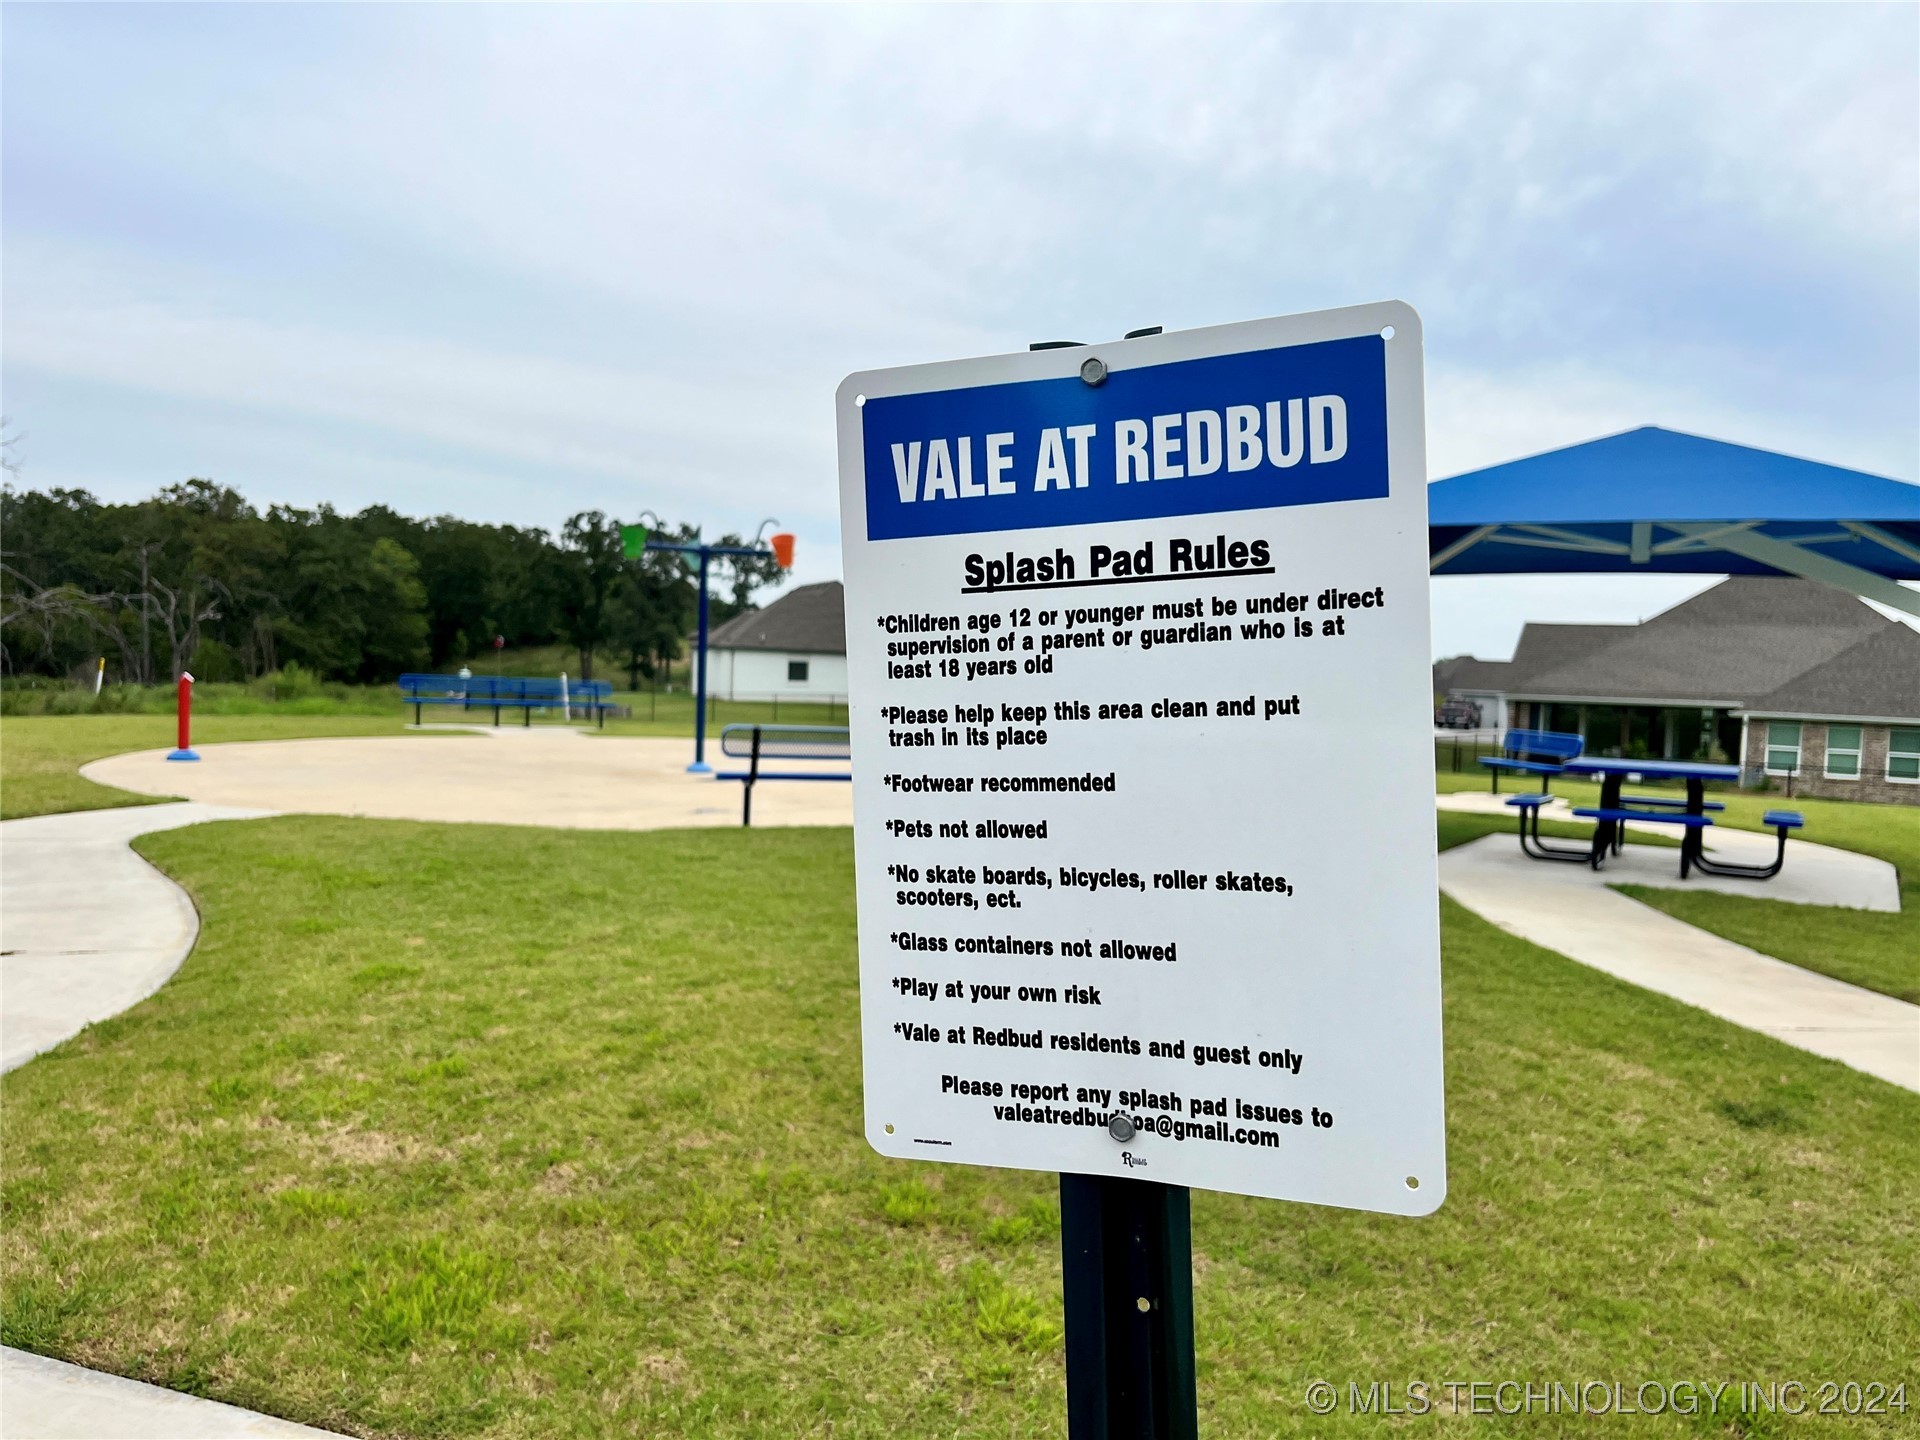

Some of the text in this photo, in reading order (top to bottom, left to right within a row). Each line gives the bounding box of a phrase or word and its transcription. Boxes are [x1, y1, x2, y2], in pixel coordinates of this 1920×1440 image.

[891, 394, 1347, 502] VALE AT REDBUD
[964, 534, 1270, 592] Splash Pad Rules
[967, 613, 1001, 633] age
[1009, 607, 1030, 627] 12
[1037, 610, 1057, 626] or
[1064, 604, 1144, 629] younger
[1152, 597, 1203, 619] must
[1211, 596, 1237, 616] be
[1245, 591, 1308, 614] under
[1317, 586, 1384, 610] direct
[887, 615, 1344, 660] supervision of a parent or guardian who is at
[887, 653, 1052, 681] least 18 years old
[955, 703, 994, 727] help
[1001, 702, 1047, 726] keep
[1053, 700, 1090, 720] this
[1098, 702, 1143, 719] area
[1150, 697, 1207, 718] clean
[1216, 695, 1255, 716] and
[1264, 694, 1299, 720] put
[888, 726, 1047, 750] trash in its place
[980, 772, 1115, 792] recommended
[939, 819, 968, 838] not
[975, 819, 1047, 839] allowed
[925, 864, 976, 884] skate
[982, 865, 1052, 889] boards,
[1059, 866, 1145, 892] bicycles,
[1153, 869, 1207, 889] roller
[1215, 870, 1293, 896] skates,
[896, 888, 1021, 910] scooters, ect.
[954, 935, 1053, 955] containers
[1060, 938, 1092, 957] not
[1099, 939, 1176, 961] allowed
[944, 979, 963, 998] at
[969, 984, 1010, 1003] your
[1017, 986, 1057, 1002] own
[1064, 984, 1101, 1005] risk
[946, 1025, 965, 1044] at
[972, 1025, 1042, 1048] Redbud
[1050, 1031, 1141, 1055] residents
[1148, 1039, 1184, 1059] and
[1192, 1045, 1250, 1065] guest
[1258, 1048, 1302, 1074] only
[941, 1074, 1333, 1128] Please report any splash pad issues to
[993, 1104, 1279, 1147] valeatredbuoa@gmail.com
